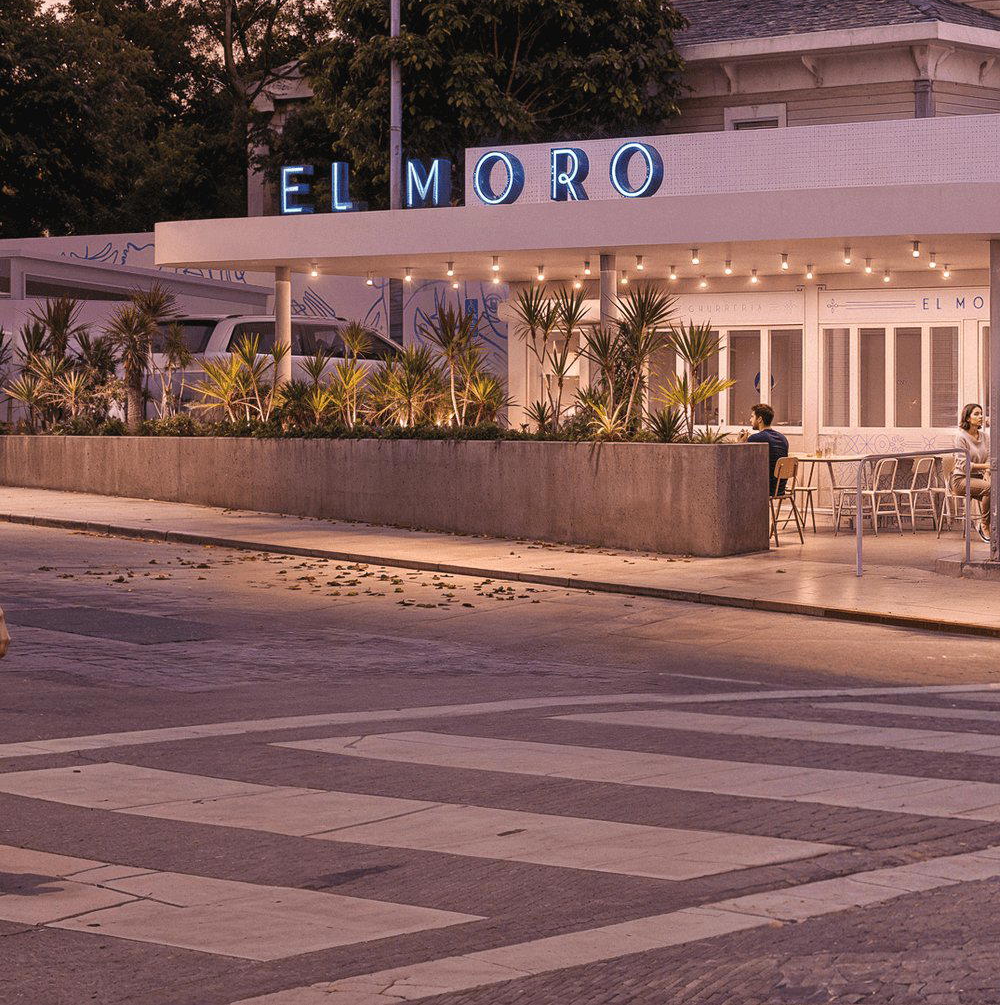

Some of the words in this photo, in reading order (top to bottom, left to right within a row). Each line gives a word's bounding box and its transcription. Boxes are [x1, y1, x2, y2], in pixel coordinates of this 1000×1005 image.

[281, 161, 352, 214] EL
[406, 141, 664, 207] MORO
[922, 297, 942, 310] EL
